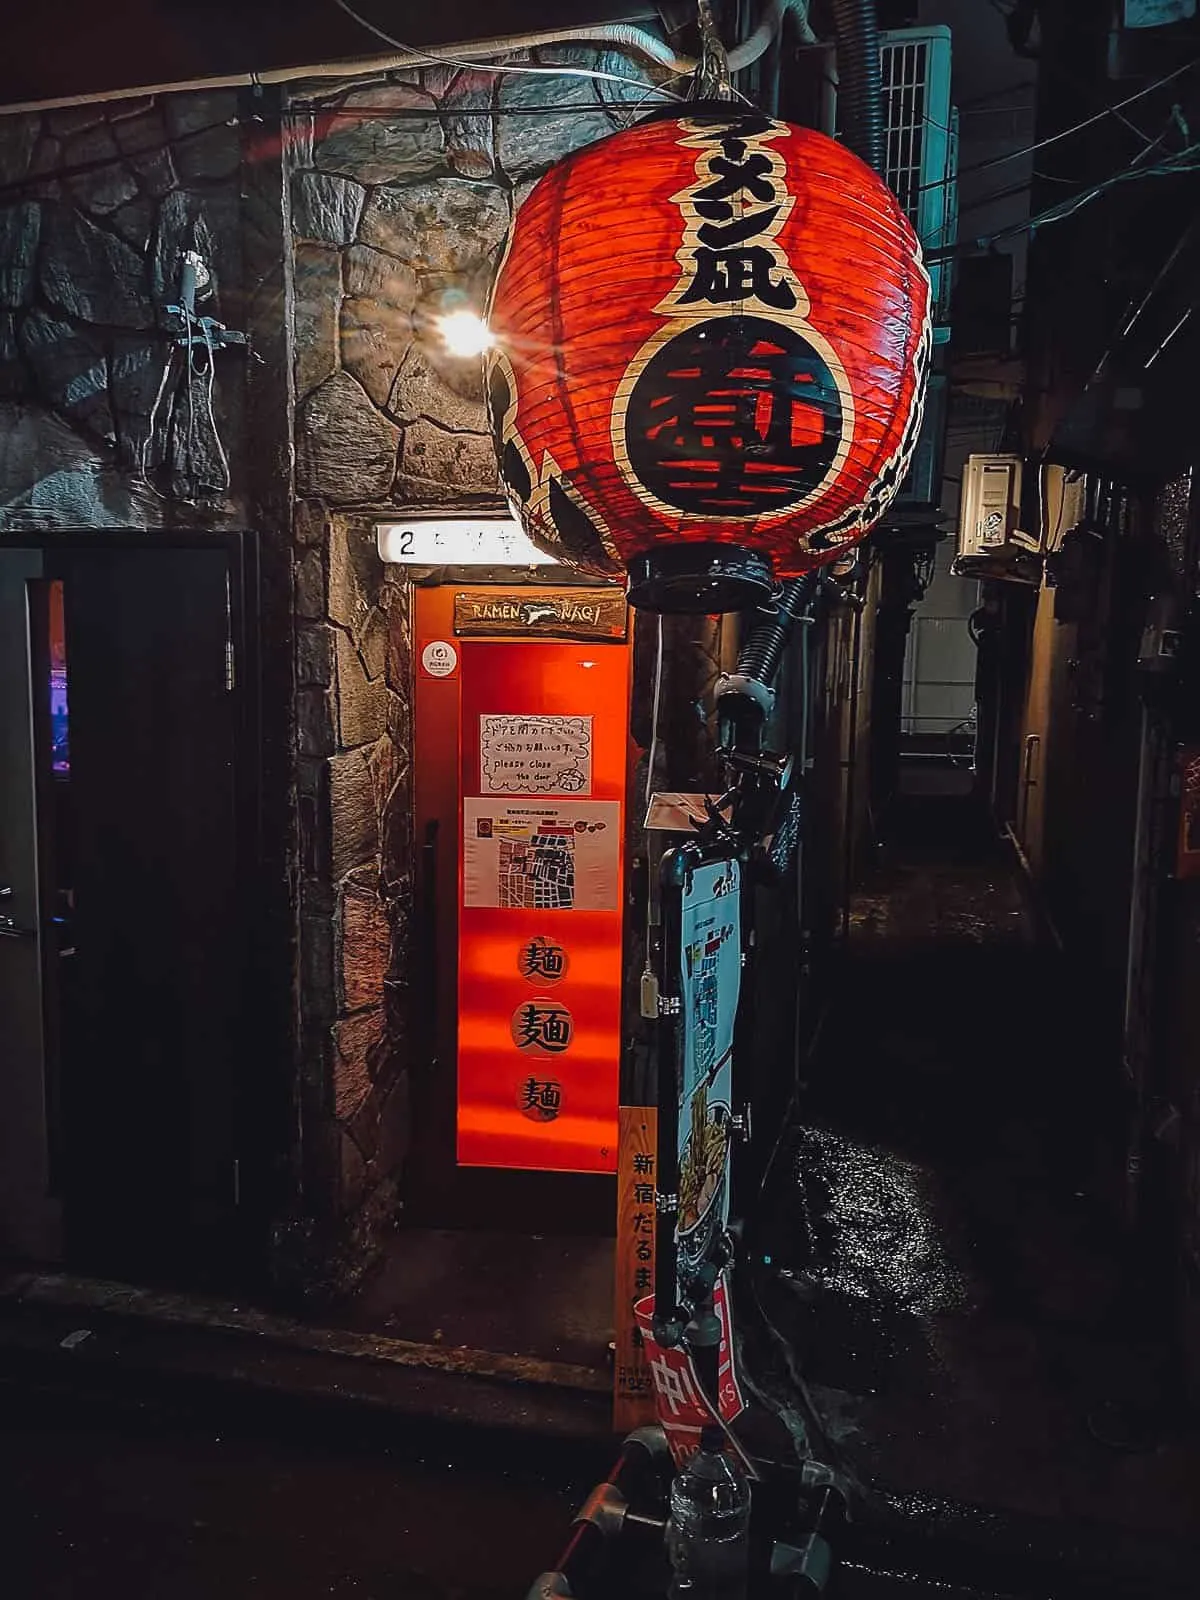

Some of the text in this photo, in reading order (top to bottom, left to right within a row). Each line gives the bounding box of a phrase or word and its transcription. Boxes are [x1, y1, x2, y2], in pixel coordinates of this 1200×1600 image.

[399, 531, 416, 556] 2
[471, 604, 601, 626] RAMEN NAGI
[494, 760, 553, 773] please close
[516, 773, 551, 781] the door
[525, 942, 563, 981] 麺
[518, 1003, 571, 1052] 麺
[522, 1077, 562, 1114] 麺
